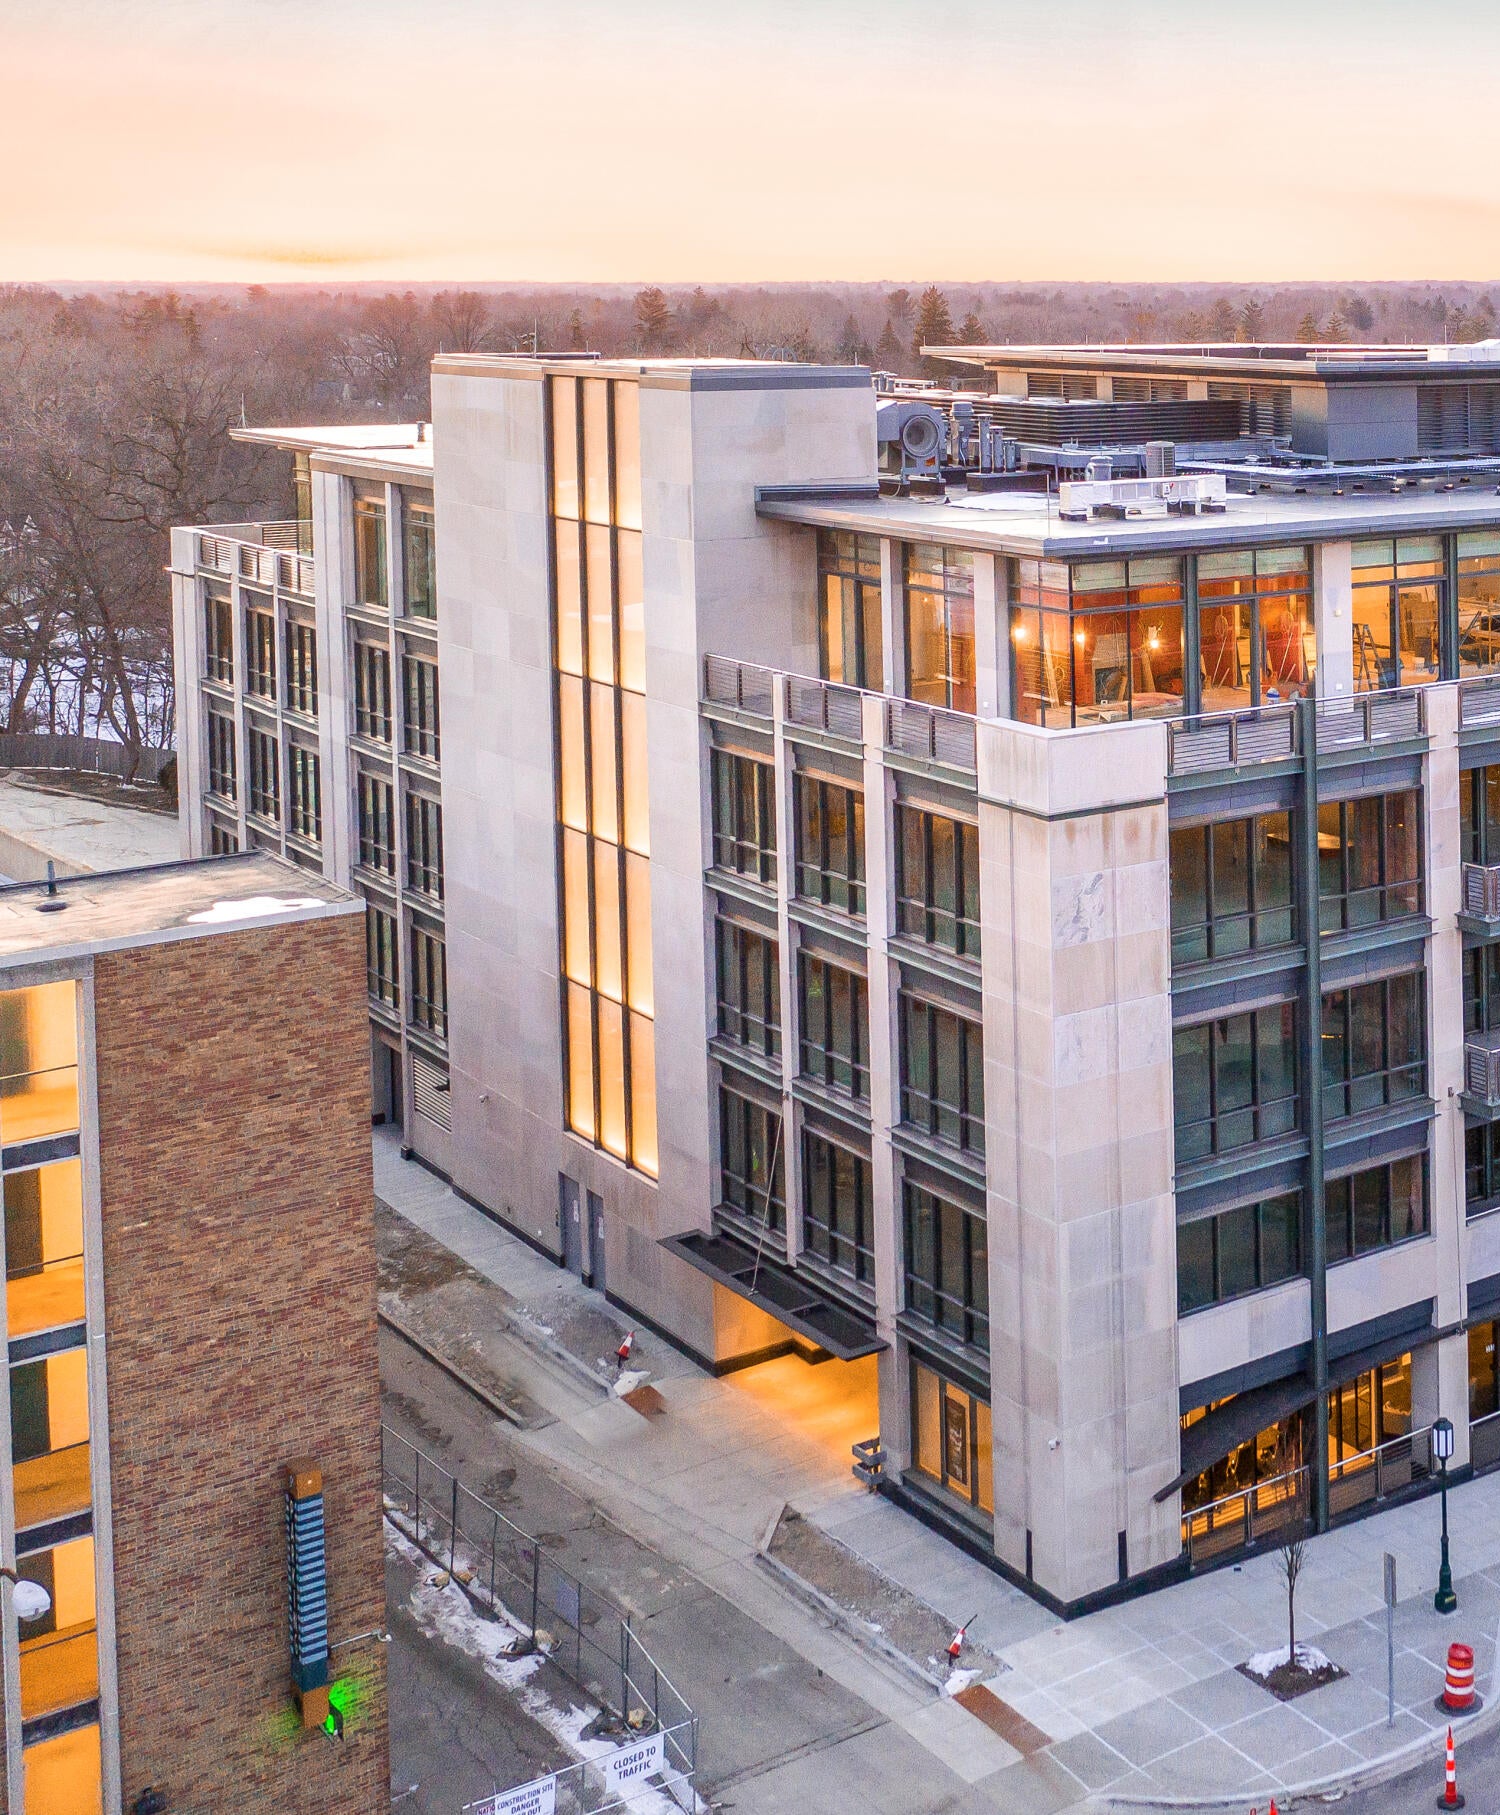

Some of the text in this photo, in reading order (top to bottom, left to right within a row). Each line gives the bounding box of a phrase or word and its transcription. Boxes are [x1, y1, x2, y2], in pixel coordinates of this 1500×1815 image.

[613, 1746, 656, 1770] CLOSED TO
[619, 1760, 651, 1780] TRAFFIC
[497, 1783, 553, 1810] CONSTRUCTION SITE
[511, 1797, 540, 1815] DANGER
